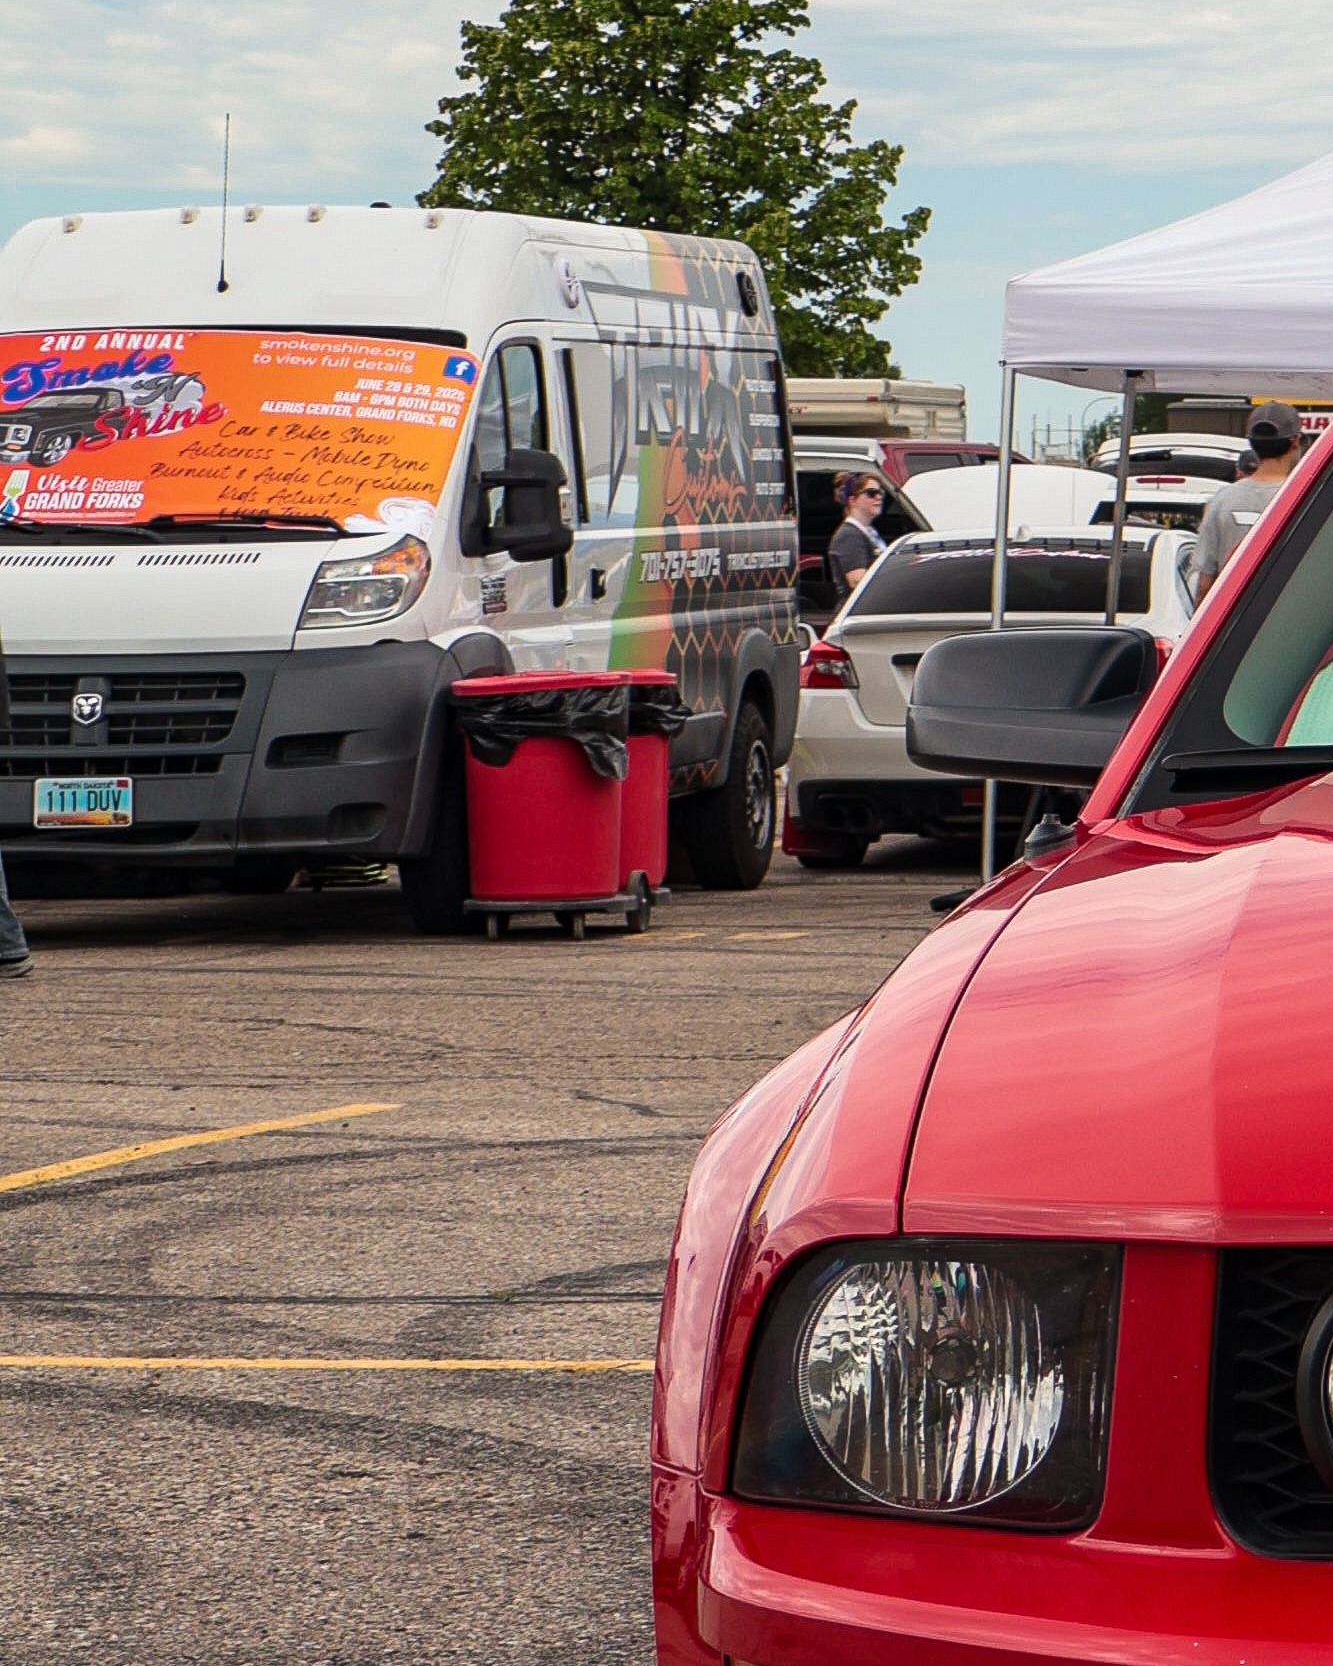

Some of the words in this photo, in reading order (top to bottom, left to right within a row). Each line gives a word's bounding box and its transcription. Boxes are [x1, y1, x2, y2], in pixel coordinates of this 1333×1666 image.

[39, 334, 87, 352] 2ND
[94, 333, 185, 351] ANNUAL
[260, 339, 415, 361] smokenshine.org
[253, 354, 273, 365] to
[276, 355, 317, 366] view
[321, 354, 349, 368] full
[353, 358, 415, 374] details
[1, 349, 175, 403] Smoke
[354, 378, 384, 391] JUNE
[260, 400, 305, 414] ALERUS
[306, 402, 353, 417] CENTER,
[355, 407, 396, 421] GRAND
[396, 410, 436, 426] FORKS,
[439, 415, 457, 428] ND
[370, 393, 396, 406] 6PM
[397, 396, 429, 410] BOTH
[430, 399, 461, 415] DAYS
[77, 402, 228, 452] Shine
[219, 420, 257, 438] Car
[280, 421, 331, 441] Bike
[339, 426, 396, 446] Show
[178, 440, 276, 461] Autocross
[300, 446, 371, 466] Mobile
[372, 451, 430, 474] Dyno
[37, 472, 89, 490] Visit
[92, 477, 144, 492] Greater
[149, 462, 231, 480] Burnout
[254, 466, 310, 485] Audio
[317, 470, 439, 493] Competition
[24, 492, 84, 509] GRAND
[85, 492, 144, 509] FORKS
[218, 484, 259, 502] Kids
[266, 487, 361, 506] Activities
[47, 790, 77, 812] 111
[87, 789, 122, 812] DUV
